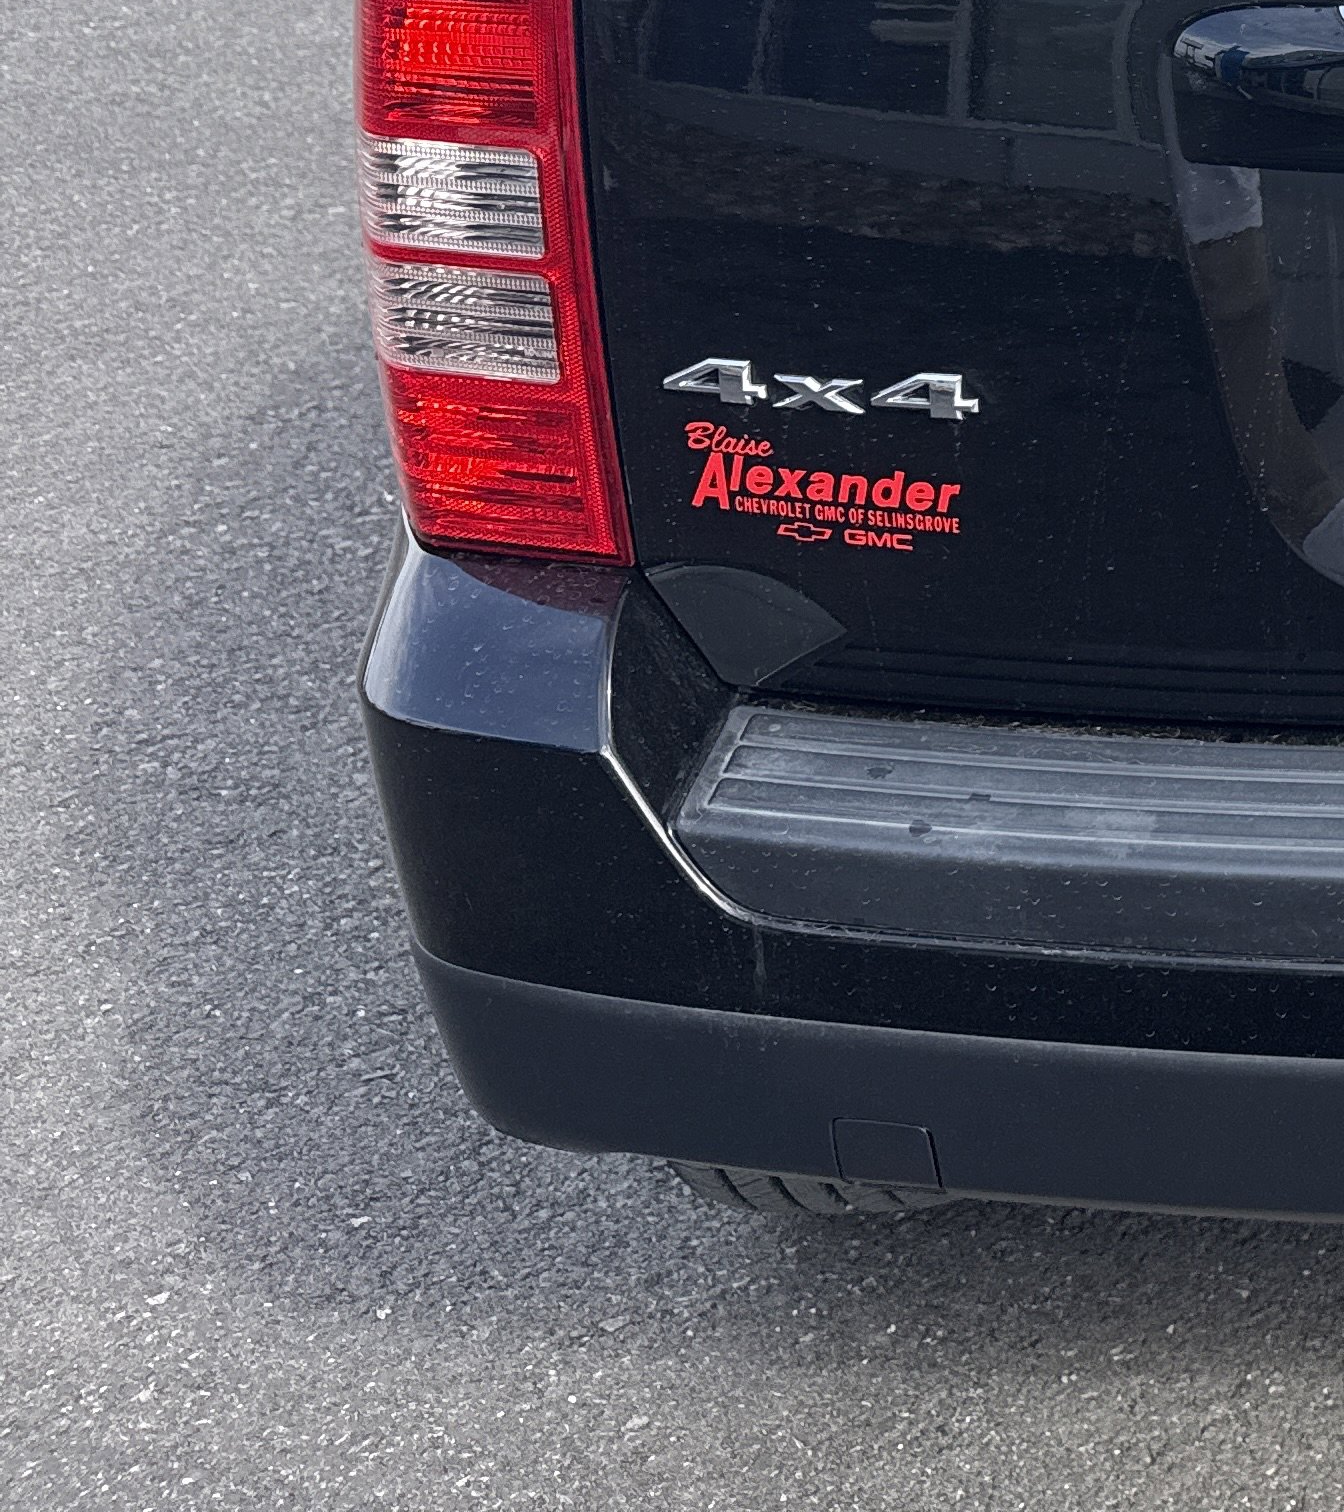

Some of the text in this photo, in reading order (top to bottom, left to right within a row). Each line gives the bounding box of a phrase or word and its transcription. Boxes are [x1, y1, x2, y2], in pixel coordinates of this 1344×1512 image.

[662, 357, 980, 421] 4x4
[685, 421, 774, 457] Blaise
[692, 452, 961, 513] Alexander
[735, 496, 961, 534] CHEVROLET GMC OF SELINSGROVE
[844, 529, 913, 551] GMC
